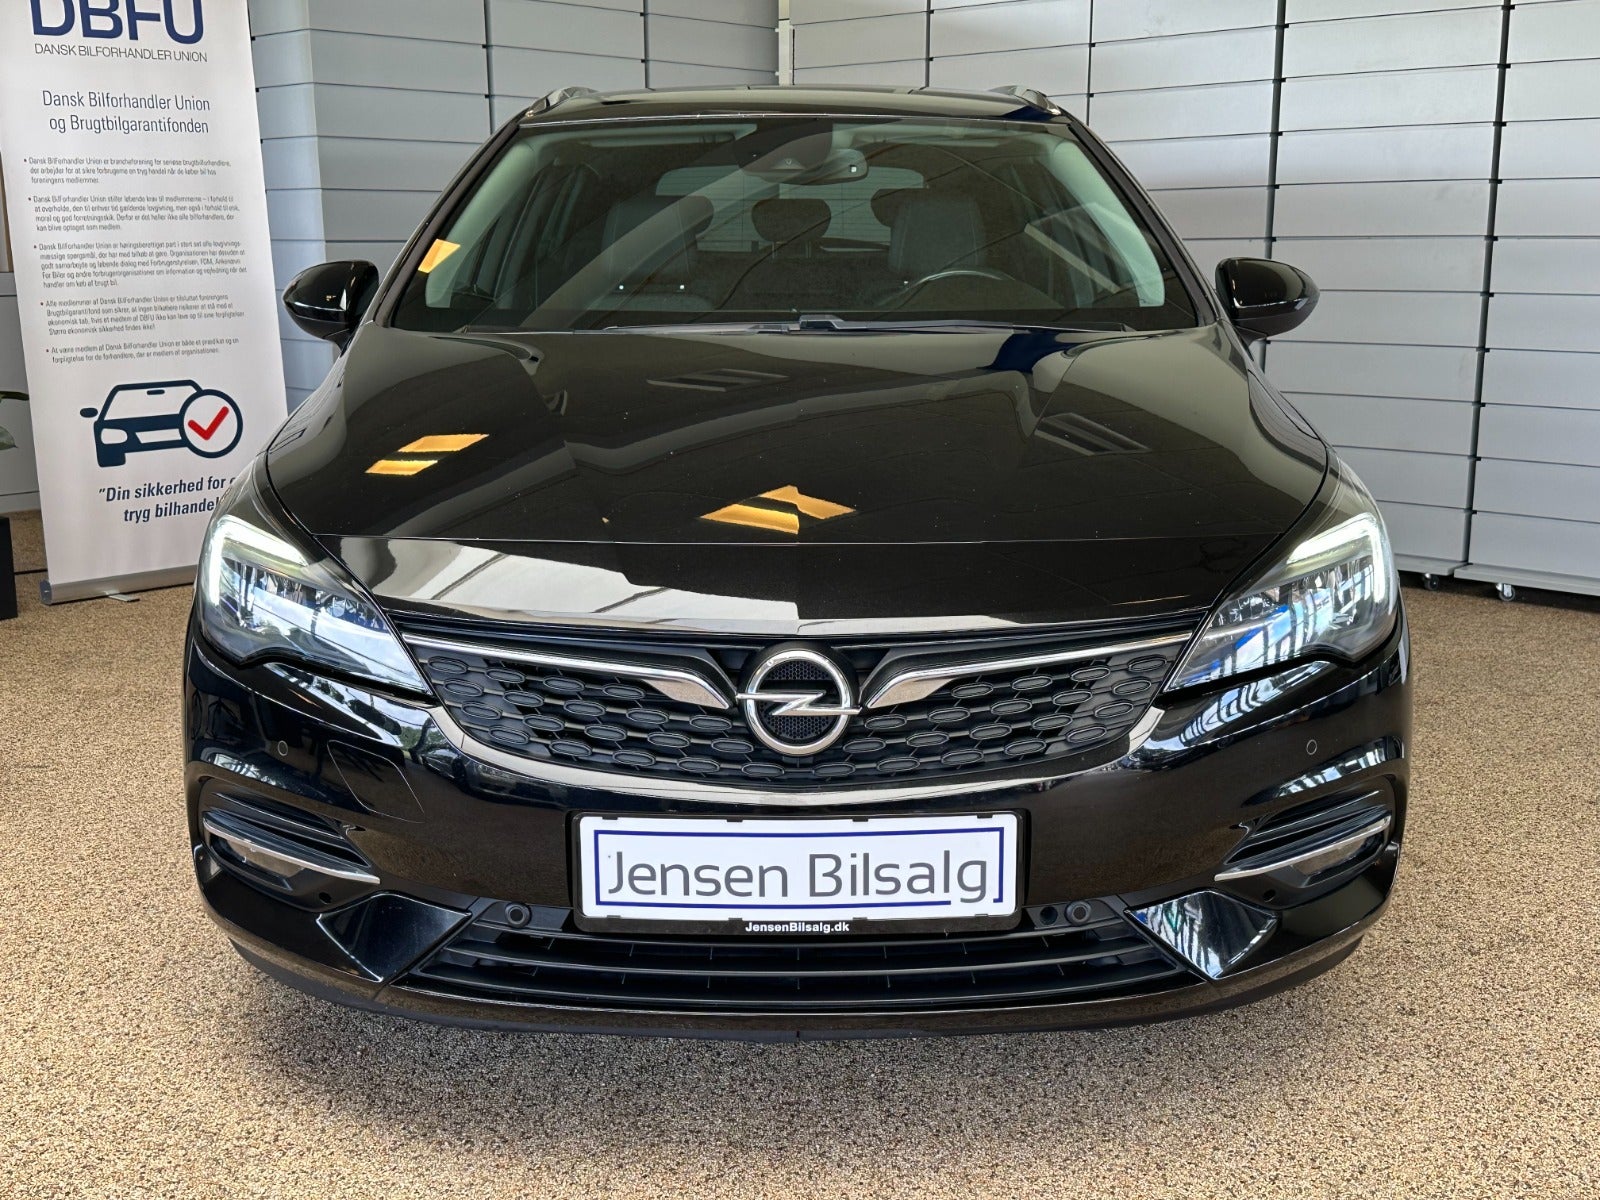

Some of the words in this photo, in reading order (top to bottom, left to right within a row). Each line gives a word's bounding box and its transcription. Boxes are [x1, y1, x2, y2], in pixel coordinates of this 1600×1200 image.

[31, 0, 204, 44] DBFU
[34, 43, 77, 56] DANSK
[78, 45, 172, 61] BILFORHANDLER
[173, 50, 208, 62] UNION
[42, 90, 85, 107] Dansk
[89, 91, 171, 110] Bilforhandler
[174, 94, 210, 111] Union
[49, 118, 66, 133] og
[70, 114, 208, 134] Brugtbilgarantifonden
[134, 477, 204, 499] sikkerhed
[207, 476, 226, 490] for
[123, 508, 150, 524] tryg
[608, 851, 788, 898] Jensen
[809, 850, 987, 904] Bilsalg
[745, 922, 850, 934] JensenBilsalg.dk
